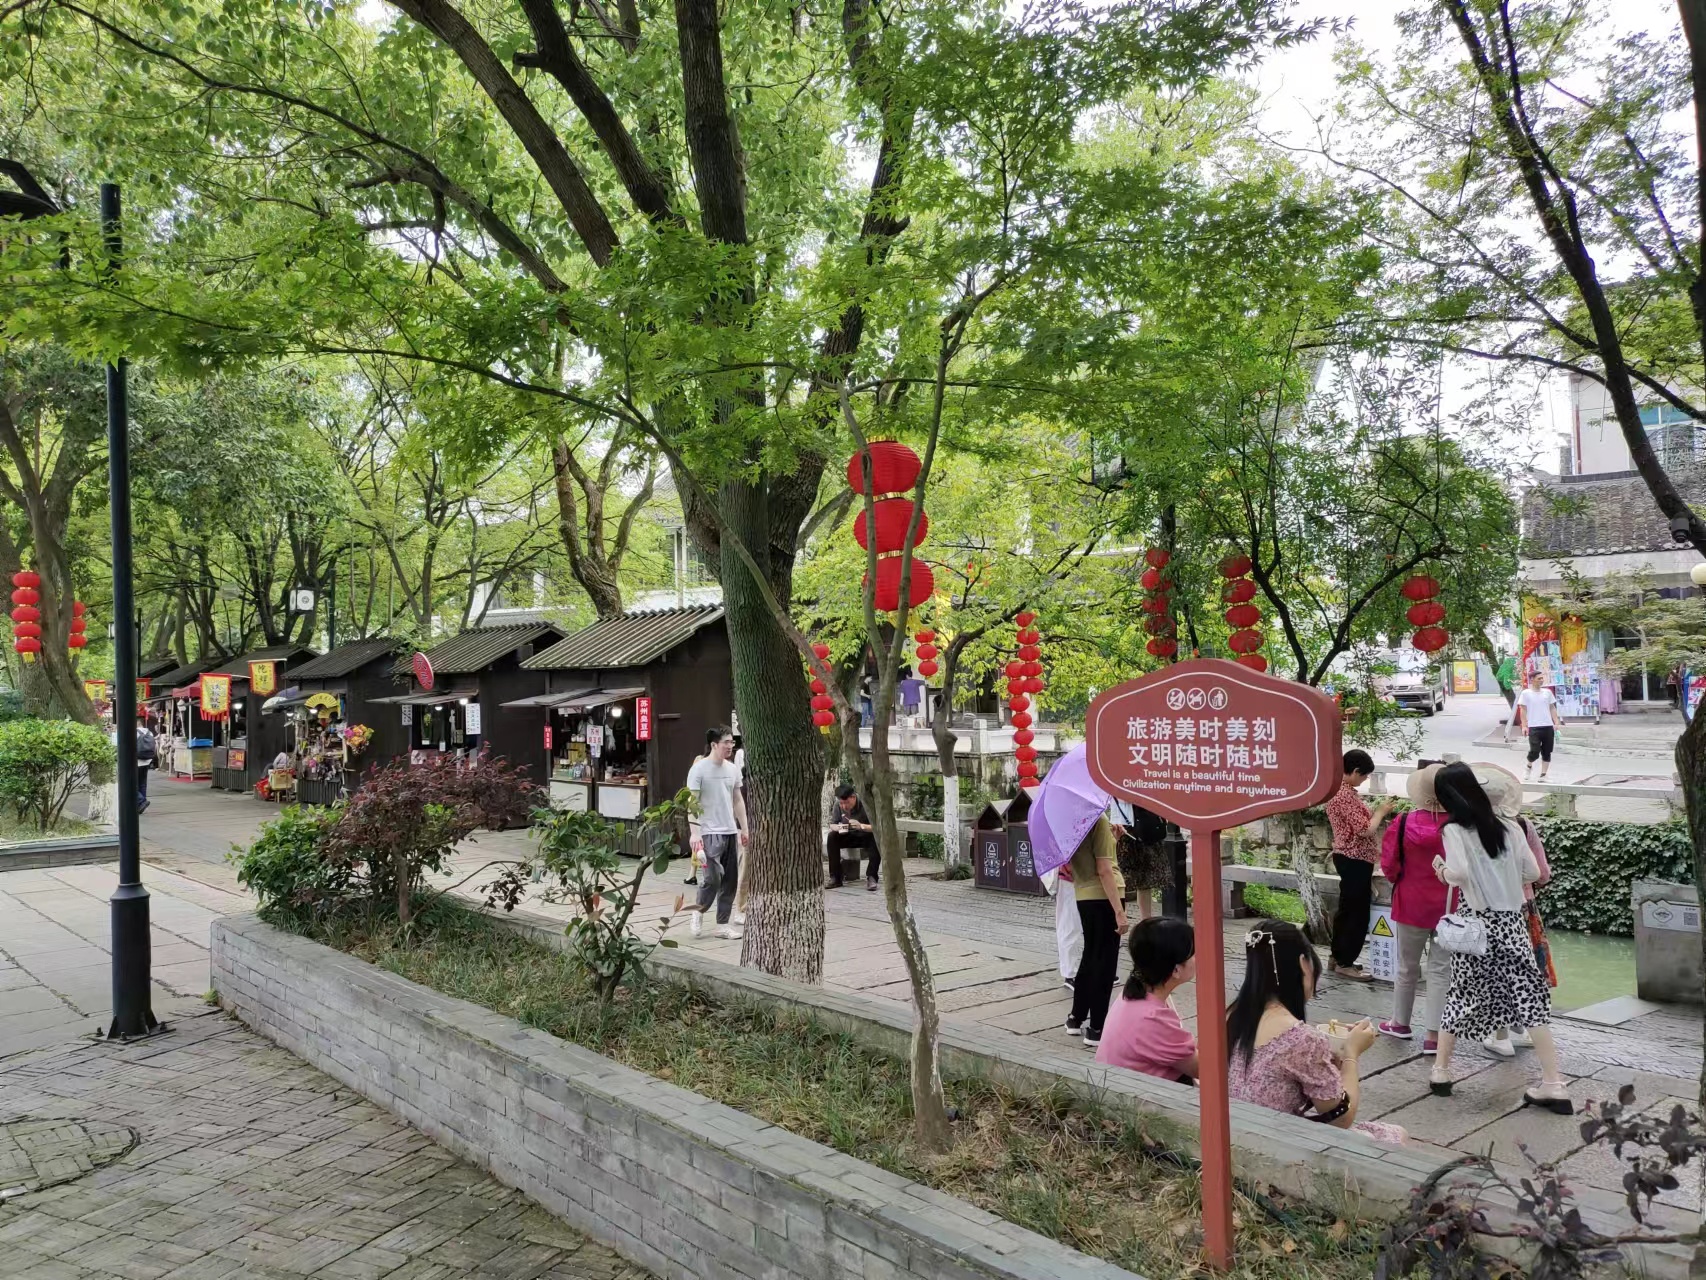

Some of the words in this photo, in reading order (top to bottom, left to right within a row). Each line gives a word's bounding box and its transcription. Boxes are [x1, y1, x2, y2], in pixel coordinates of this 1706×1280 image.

[640, 700, 649, 738] 苏州臭豆腐
[1127, 717, 1276, 741] 旅游美时美刻
[1128, 743, 1279, 769] 文明随时随地
[1122, 778, 1171, 790] Civilization
[1173, 782, 1212, 794] anytime
[1214, 783, 1233, 793] and
[1236, 785, 1287, 797] anywhere
[1143, 769, 1170, 779] Travel
[1172, 770, 1181, 779] is
[1191, 770, 1235, 782] beautiful
[1238, 772, 1261, 783] time
[1373, 940, 1381, 976] 水深危险
[1382, 942, 1390, 976] 注意安全
